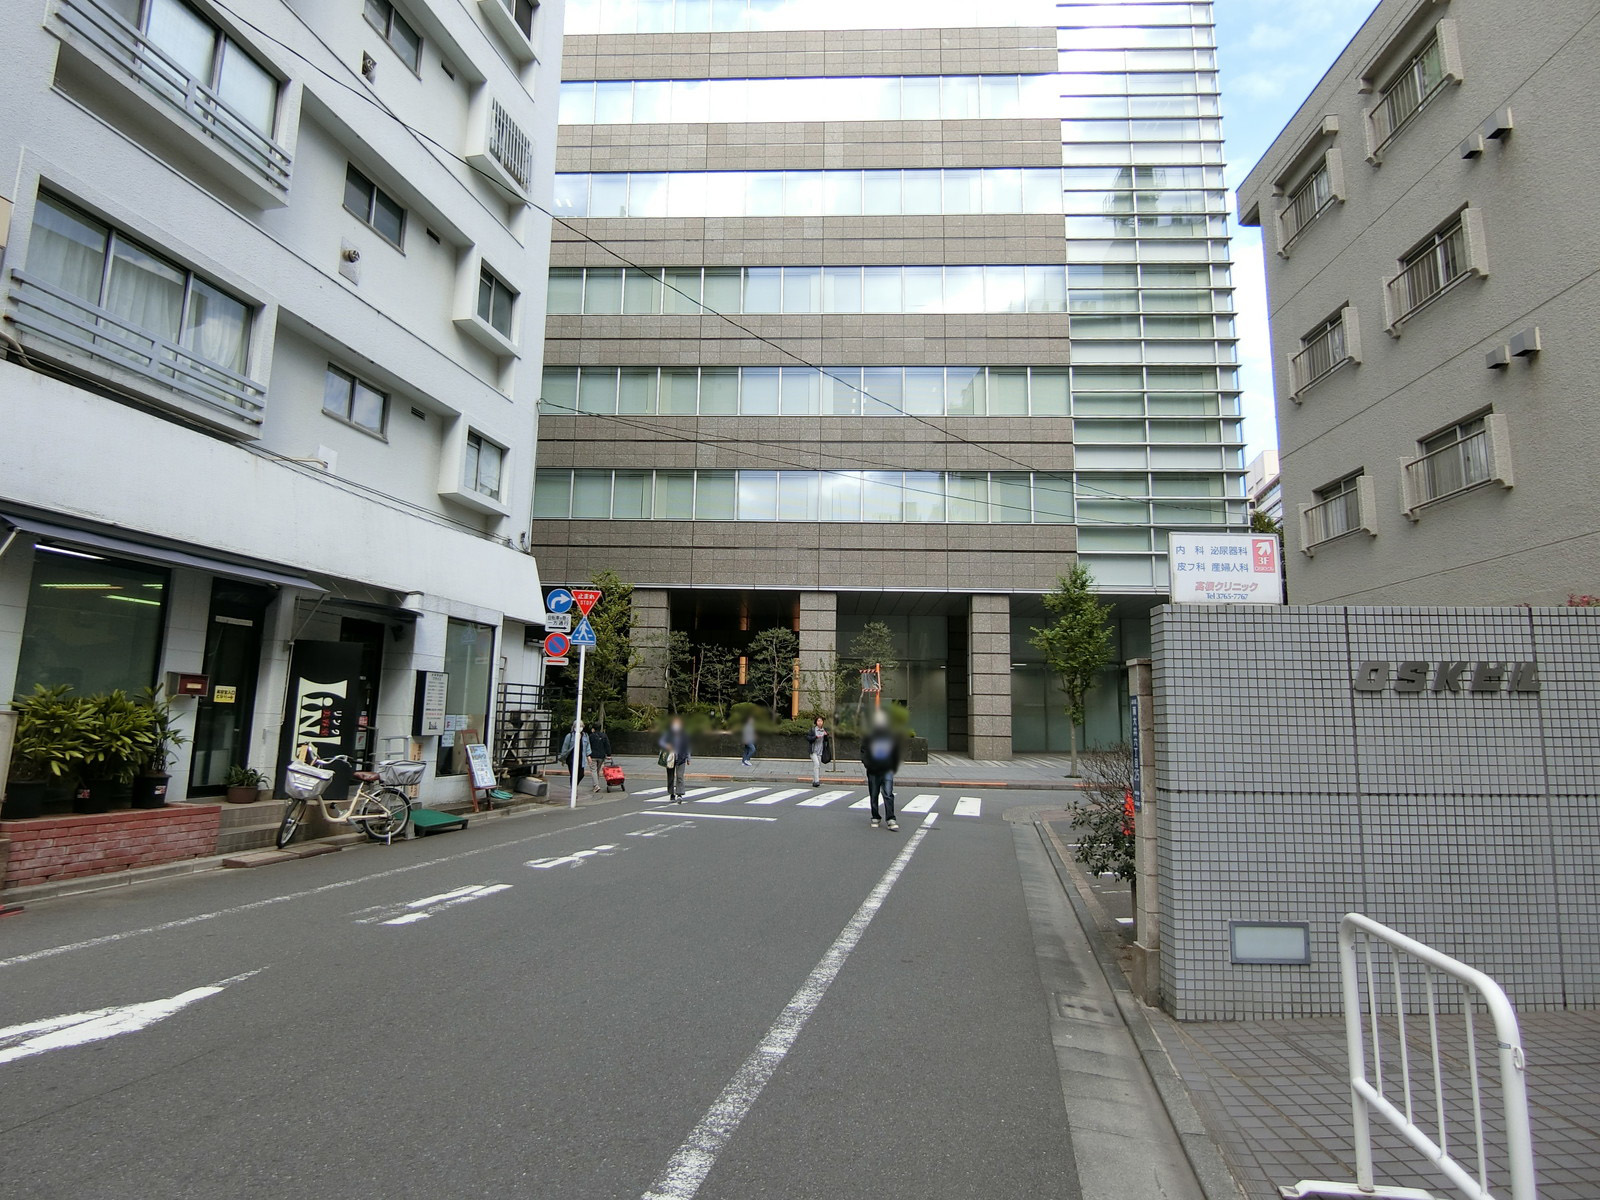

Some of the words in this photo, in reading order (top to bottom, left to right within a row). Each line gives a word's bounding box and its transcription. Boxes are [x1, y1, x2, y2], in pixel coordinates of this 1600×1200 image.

[1210, 546, 1248, 556] 泌尿器科
[1258, 556, 1270, 565] 3F
[1177, 562, 1206, 572] 皮フ科
[1211, 562, 1249, 573] 産婦人科
